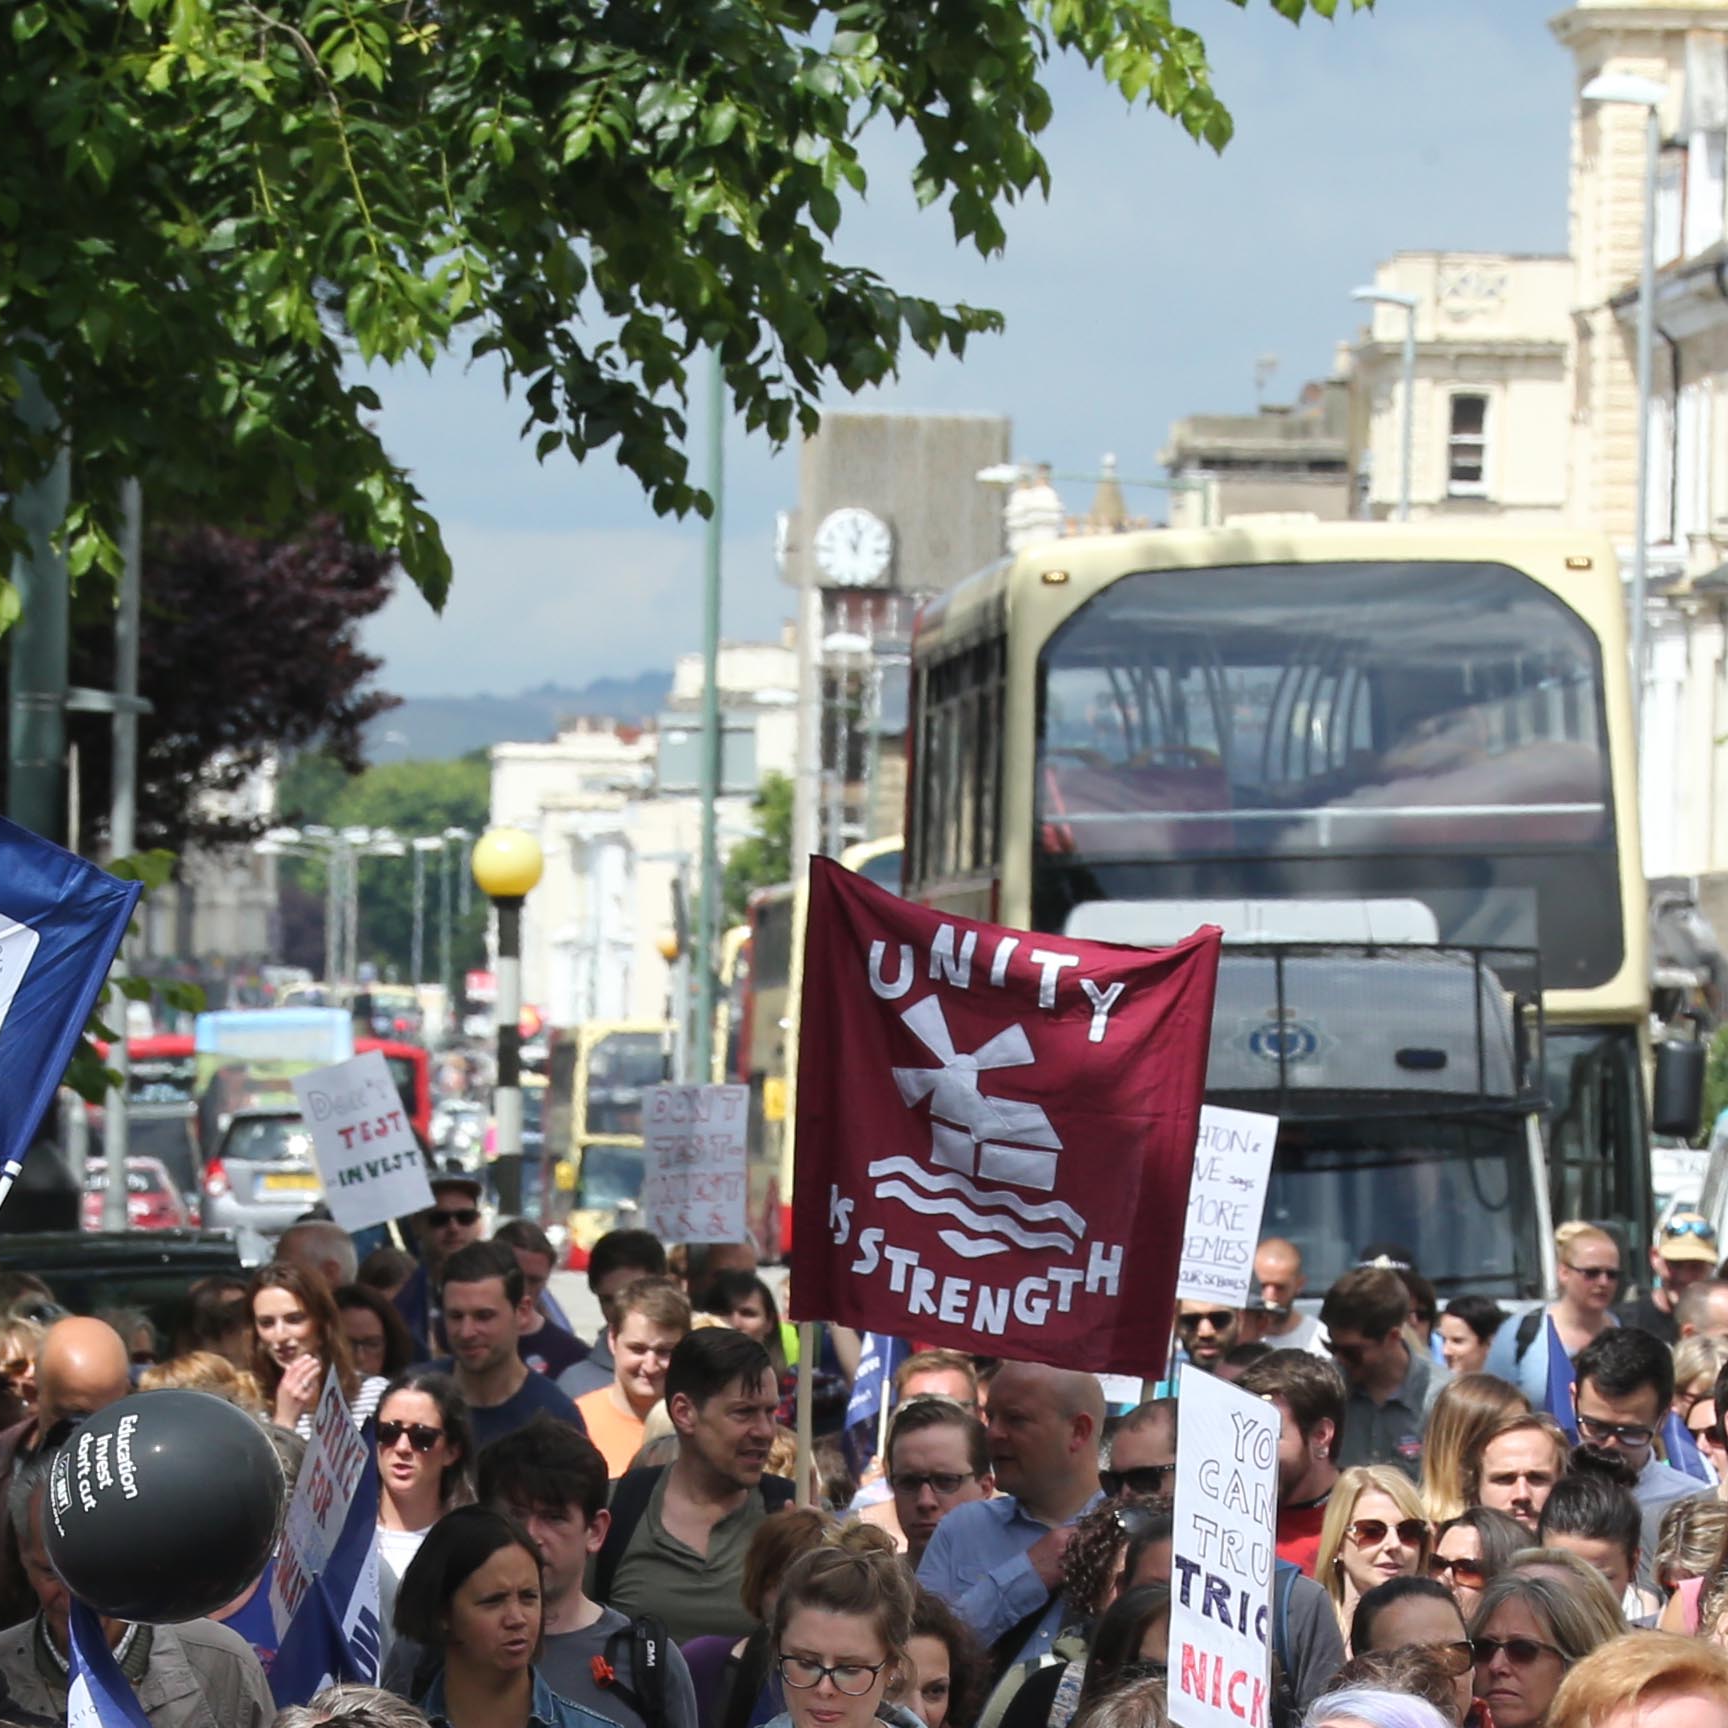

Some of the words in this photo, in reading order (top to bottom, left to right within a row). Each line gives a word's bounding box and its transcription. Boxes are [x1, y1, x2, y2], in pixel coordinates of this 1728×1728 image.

[869, 923, 1125, 1043] UNITY
[337, 1111, 404, 1151] TEST
[1197, 1126, 1251, 1153] HTON
[1194, 1156, 1223, 1182] VE
[829, 1184, 854, 1245] IS
[851, 1227, 1125, 1335] STRENGTH
[1184, 1236, 1249, 1264] EMIES
[95, 1433, 115, 1490] Invest
[116, 1414, 139, 1500] Education
[1232, 1411, 1274, 1470] YO
[79, 1479, 97, 1513] cut
[1199, 1459, 1273, 1533] CAN
[1193, 1515, 1272, 1587] TRU
[1175, 1555, 1269, 1644] TRIC
